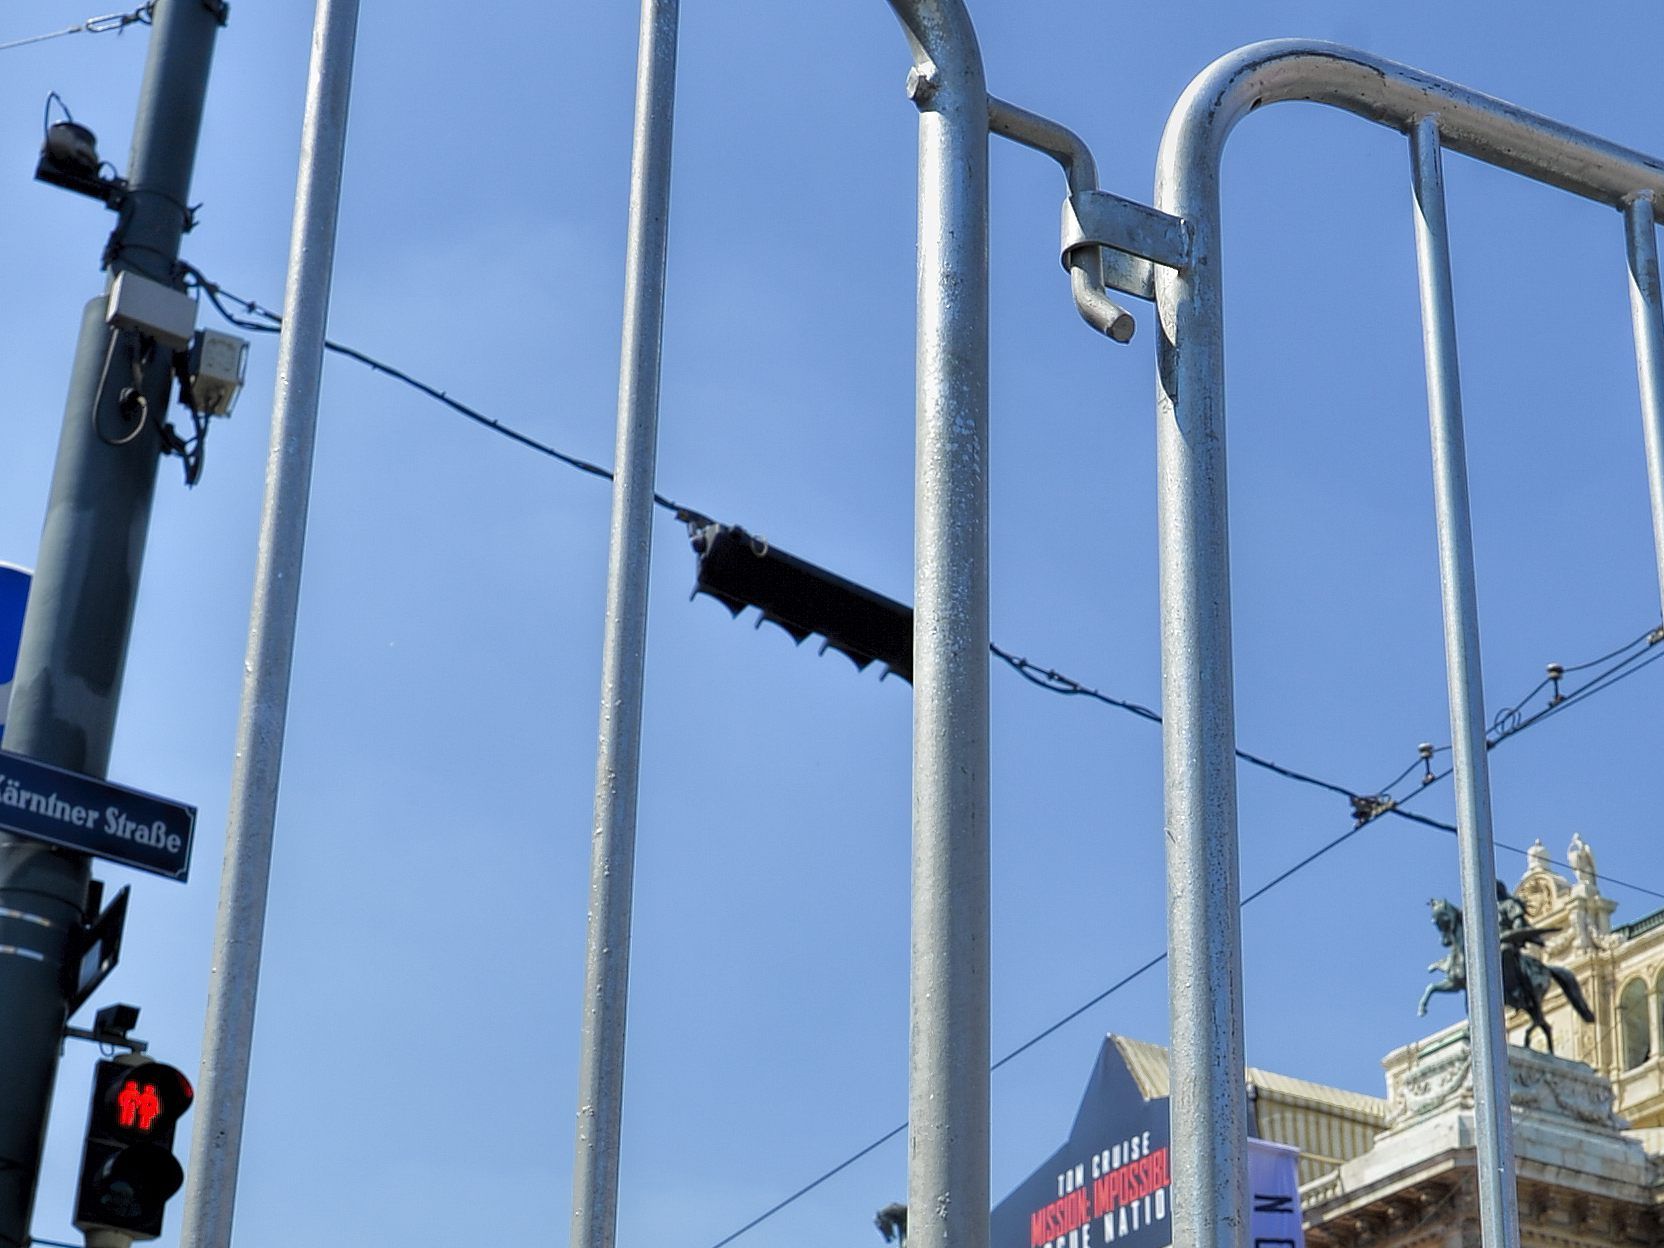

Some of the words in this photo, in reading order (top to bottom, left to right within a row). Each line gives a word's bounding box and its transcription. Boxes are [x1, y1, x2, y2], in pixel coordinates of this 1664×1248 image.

[104, 806, 182, 854] Straße
[1057, 1162, 1085, 1198] TOM
[1091, 1130, 1151, 1179] CRUISE
[1093, 1146, 1171, 1219] IMPOSSIBL
[1103, 1187, 1166, 1244] NATIO
